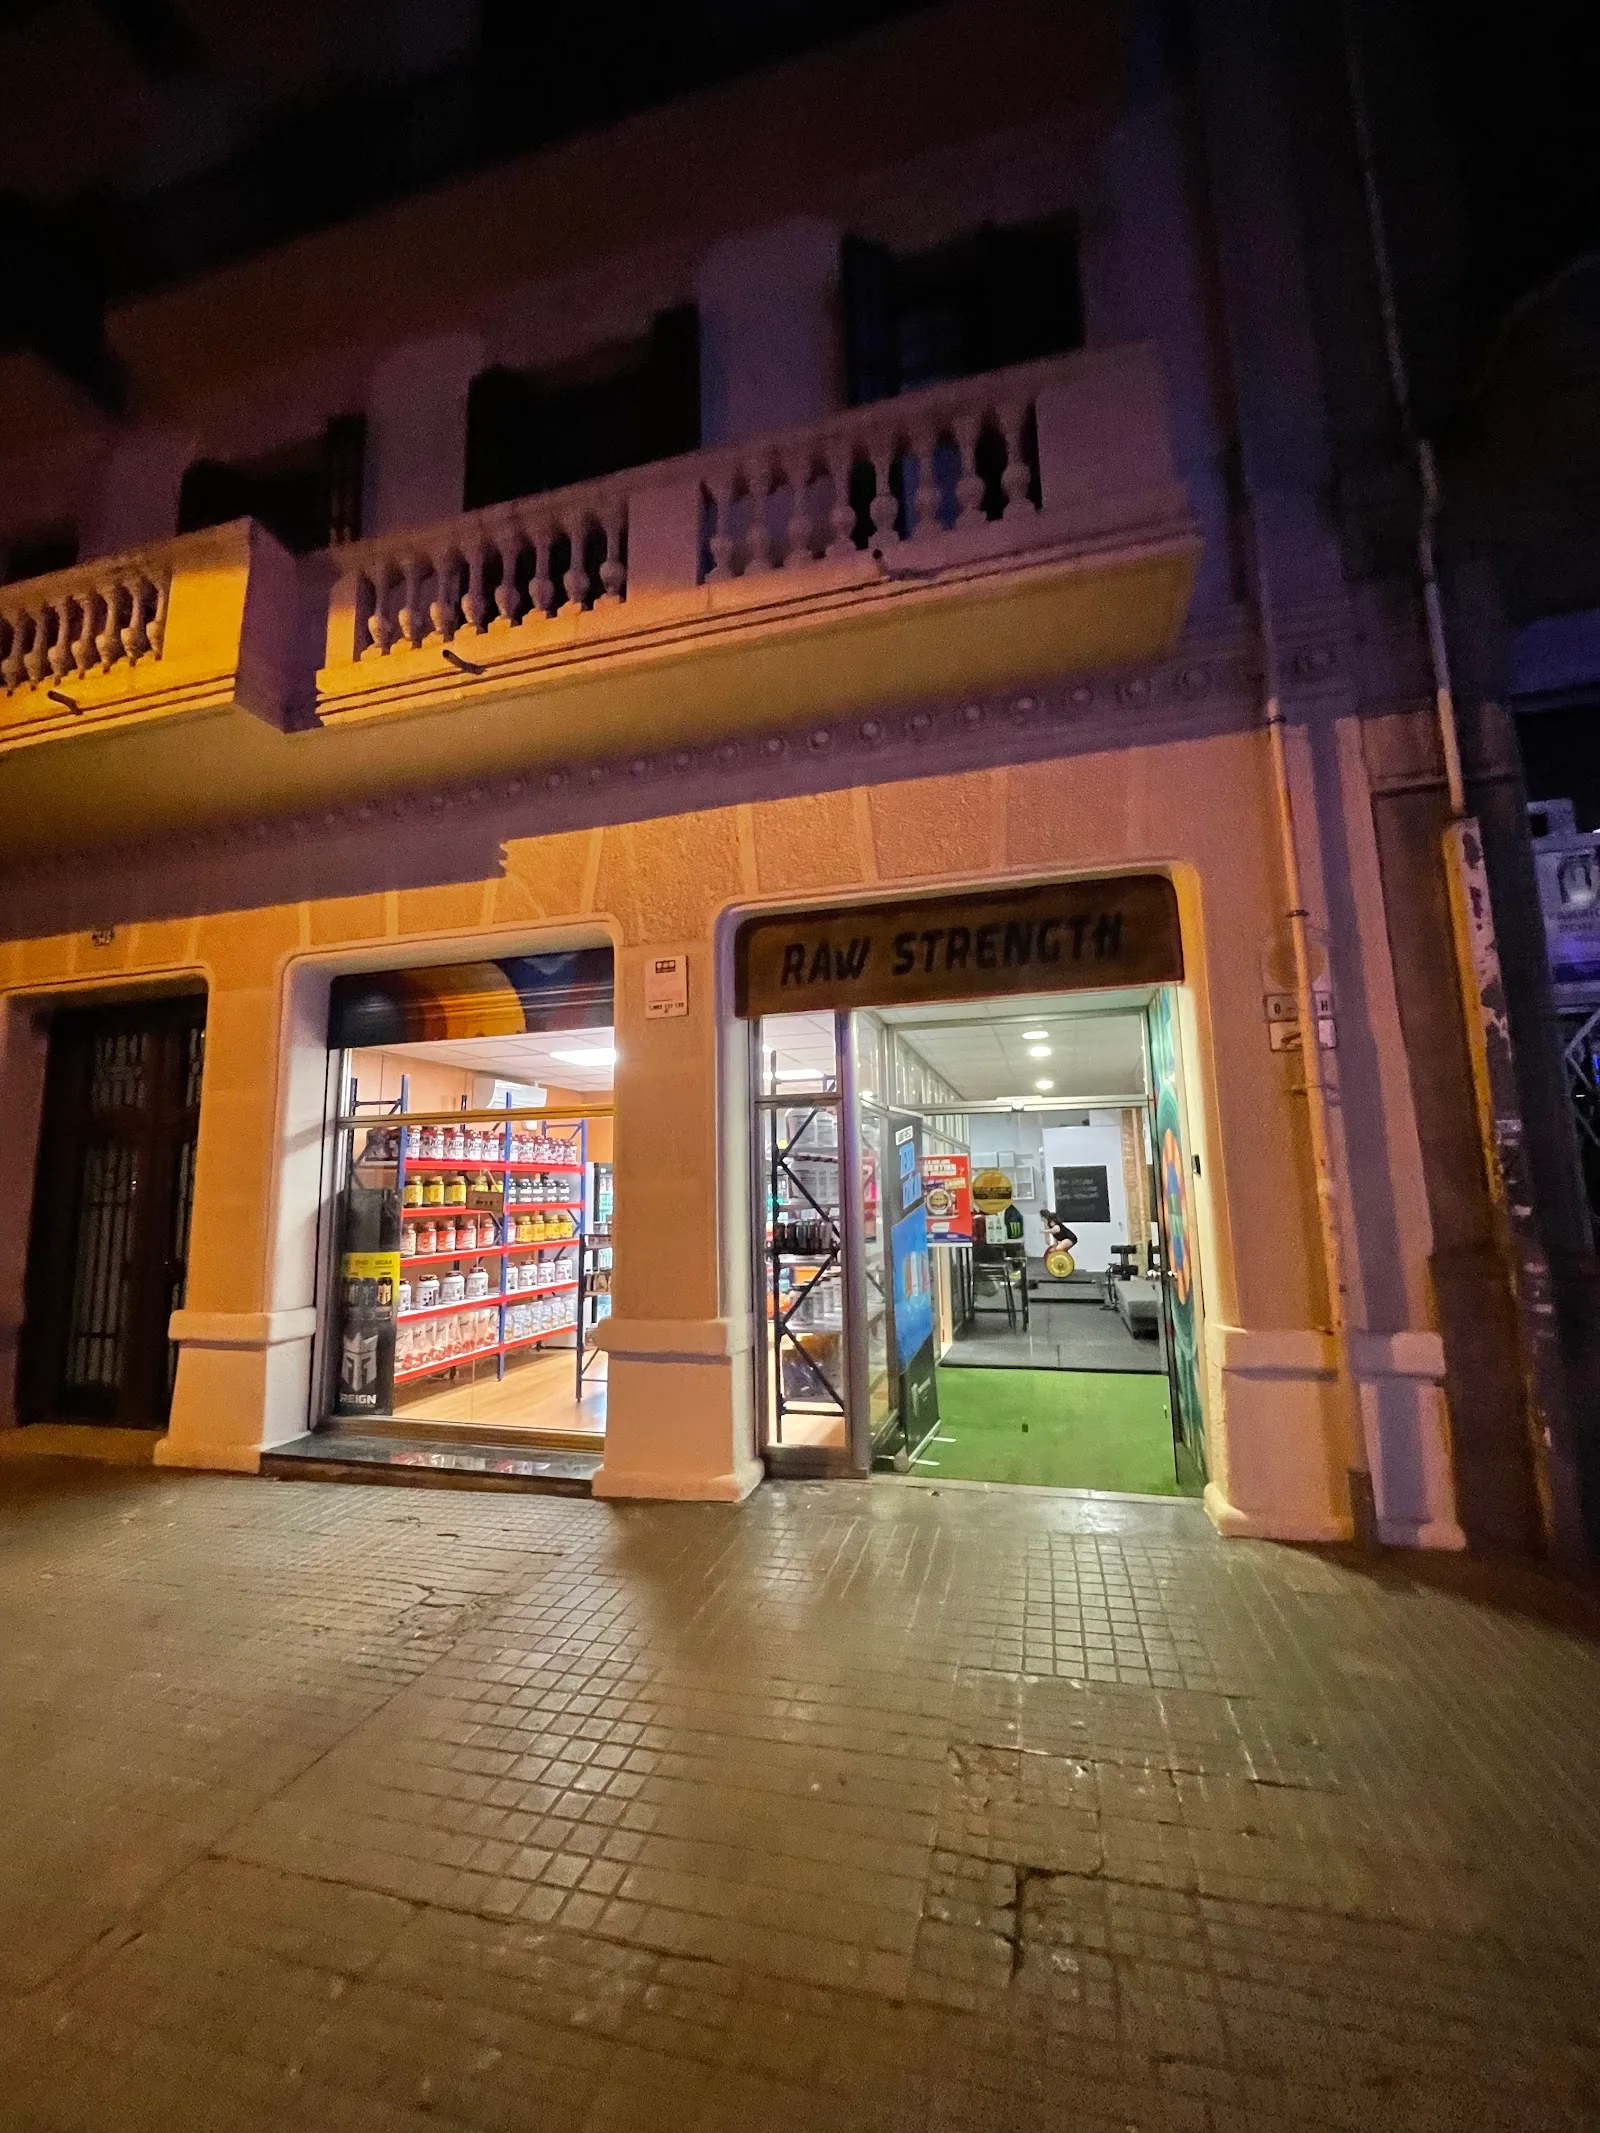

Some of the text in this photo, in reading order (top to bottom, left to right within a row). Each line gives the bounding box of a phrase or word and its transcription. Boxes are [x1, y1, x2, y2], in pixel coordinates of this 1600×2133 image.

[782, 912, 1123, 986] RAW STRENGTH
[340, 1393, 377, 1404] REIGN
